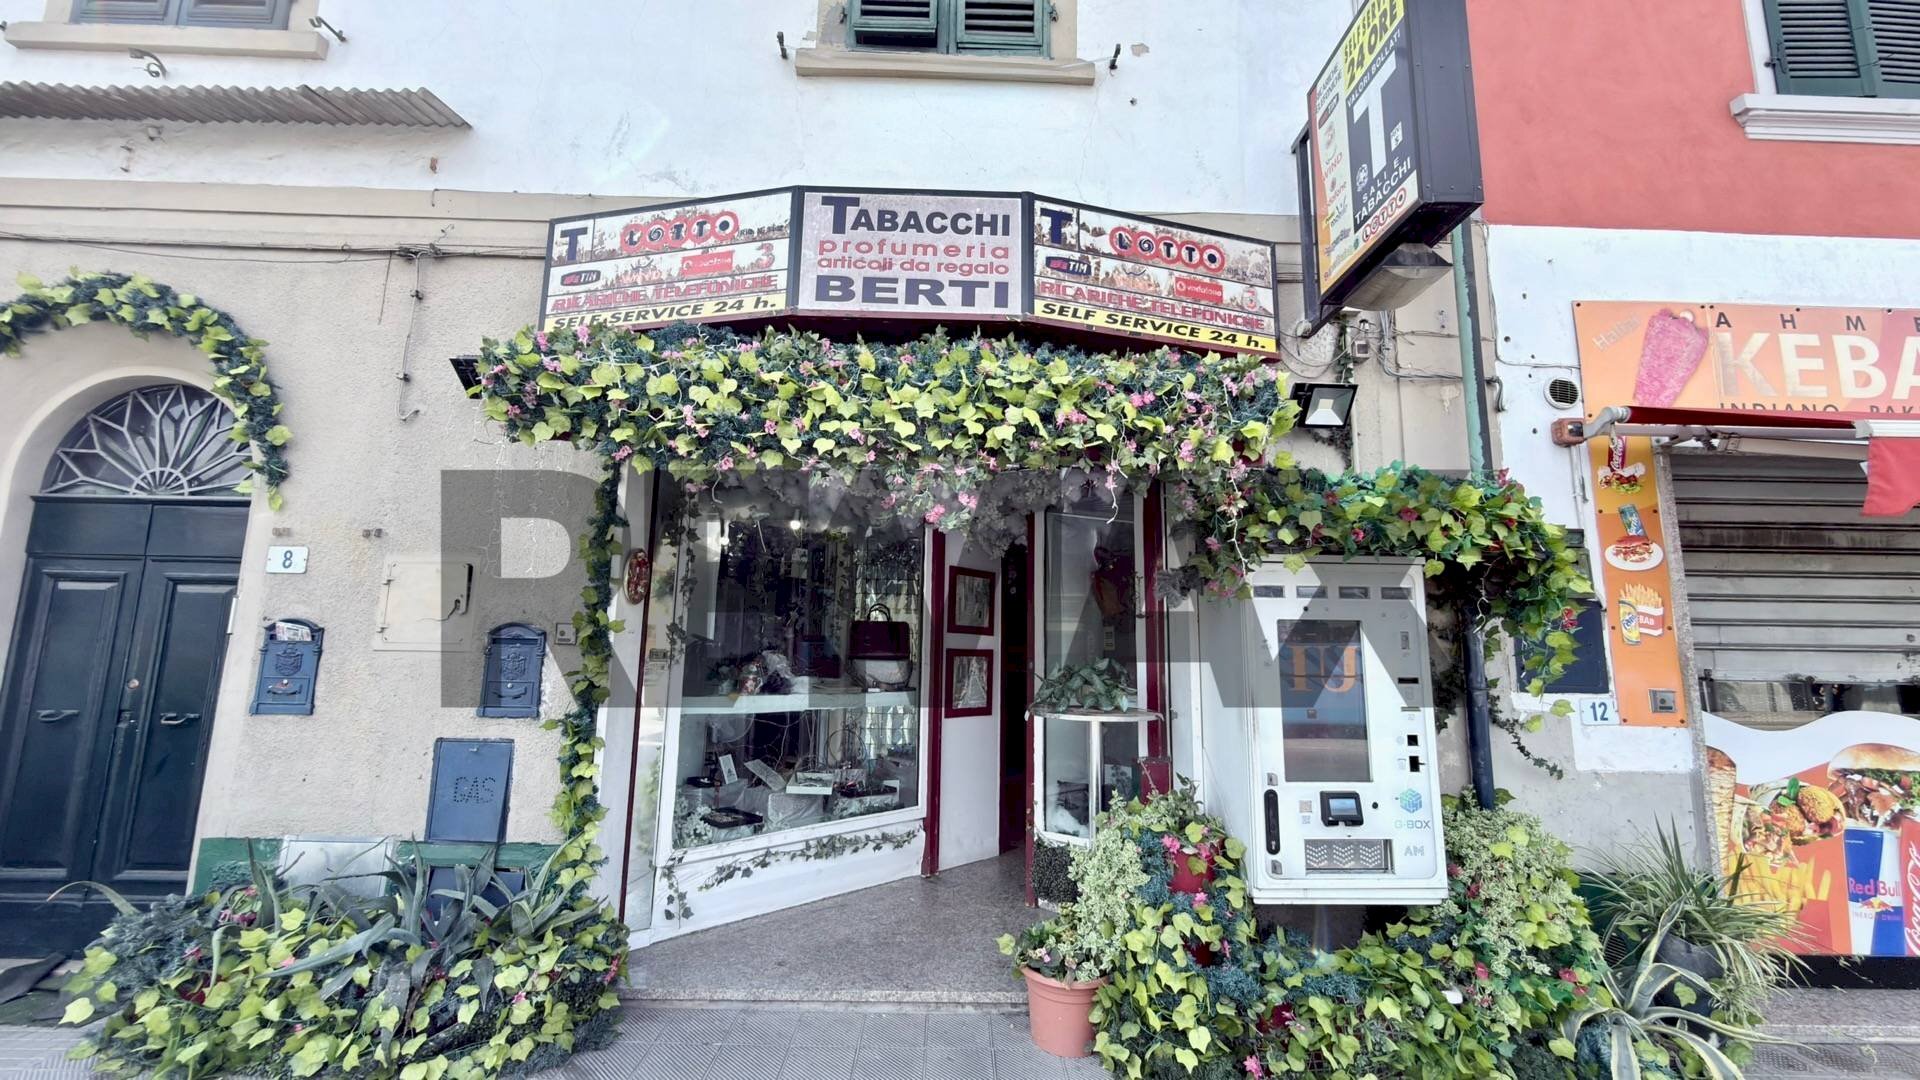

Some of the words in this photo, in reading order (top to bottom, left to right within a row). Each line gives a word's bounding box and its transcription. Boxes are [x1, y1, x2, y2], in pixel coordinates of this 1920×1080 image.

[1344, 24, 1361, 63] SELF
[1347, 43, 1365, 90] 24
[1368, 0, 1398, 56] ORE
[1347, 72, 1370, 107] VALORI
[1371, 28, 1401, 75] BOLLATI
[1353, 51, 1397, 178] T
[1354, 156, 1412, 225] TABACCHI
[1362, 172, 1387, 204] SALI
[1393, 156, 1401, 170] E
[622, 212, 736, 250] LOTTO
[821, 196, 1010, 236] TABACCHI
[1040, 208, 1073, 244] T
[1362, 187, 1407, 243] LOTTO
[560, 226, 588, 261] T
[818, 239, 1009, 259] profumeria
[1111, 229, 1224, 273] LOTTO
[900, 258, 930, 272] da
[937, 261, 1010, 276] regalo
[1069, 261, 1088, 273] TIM
[815, 274, 1009, 308] BERTI
[1039, 280, 1143, 310] RICARICHE
[1150, 300, 1265, 330] TELEFONICHE
[609, 303, 706, 325] SERVICE
[711, 298, 745, 314] 24
[753, 296, 777, 310] h.
[1042, 302, 1097, 320] SELF
[1105, 313, 1201, 338] SERVICE
[1210, 330, 1238, 344] 24
[1246, 335, 1267, 348] h.
[282, 550, 293, 569] 8
[1590, 702, 1609, 721] 12
[453, 776, 496, 804] GAS
[1847, 877, 1876, 896] Red
